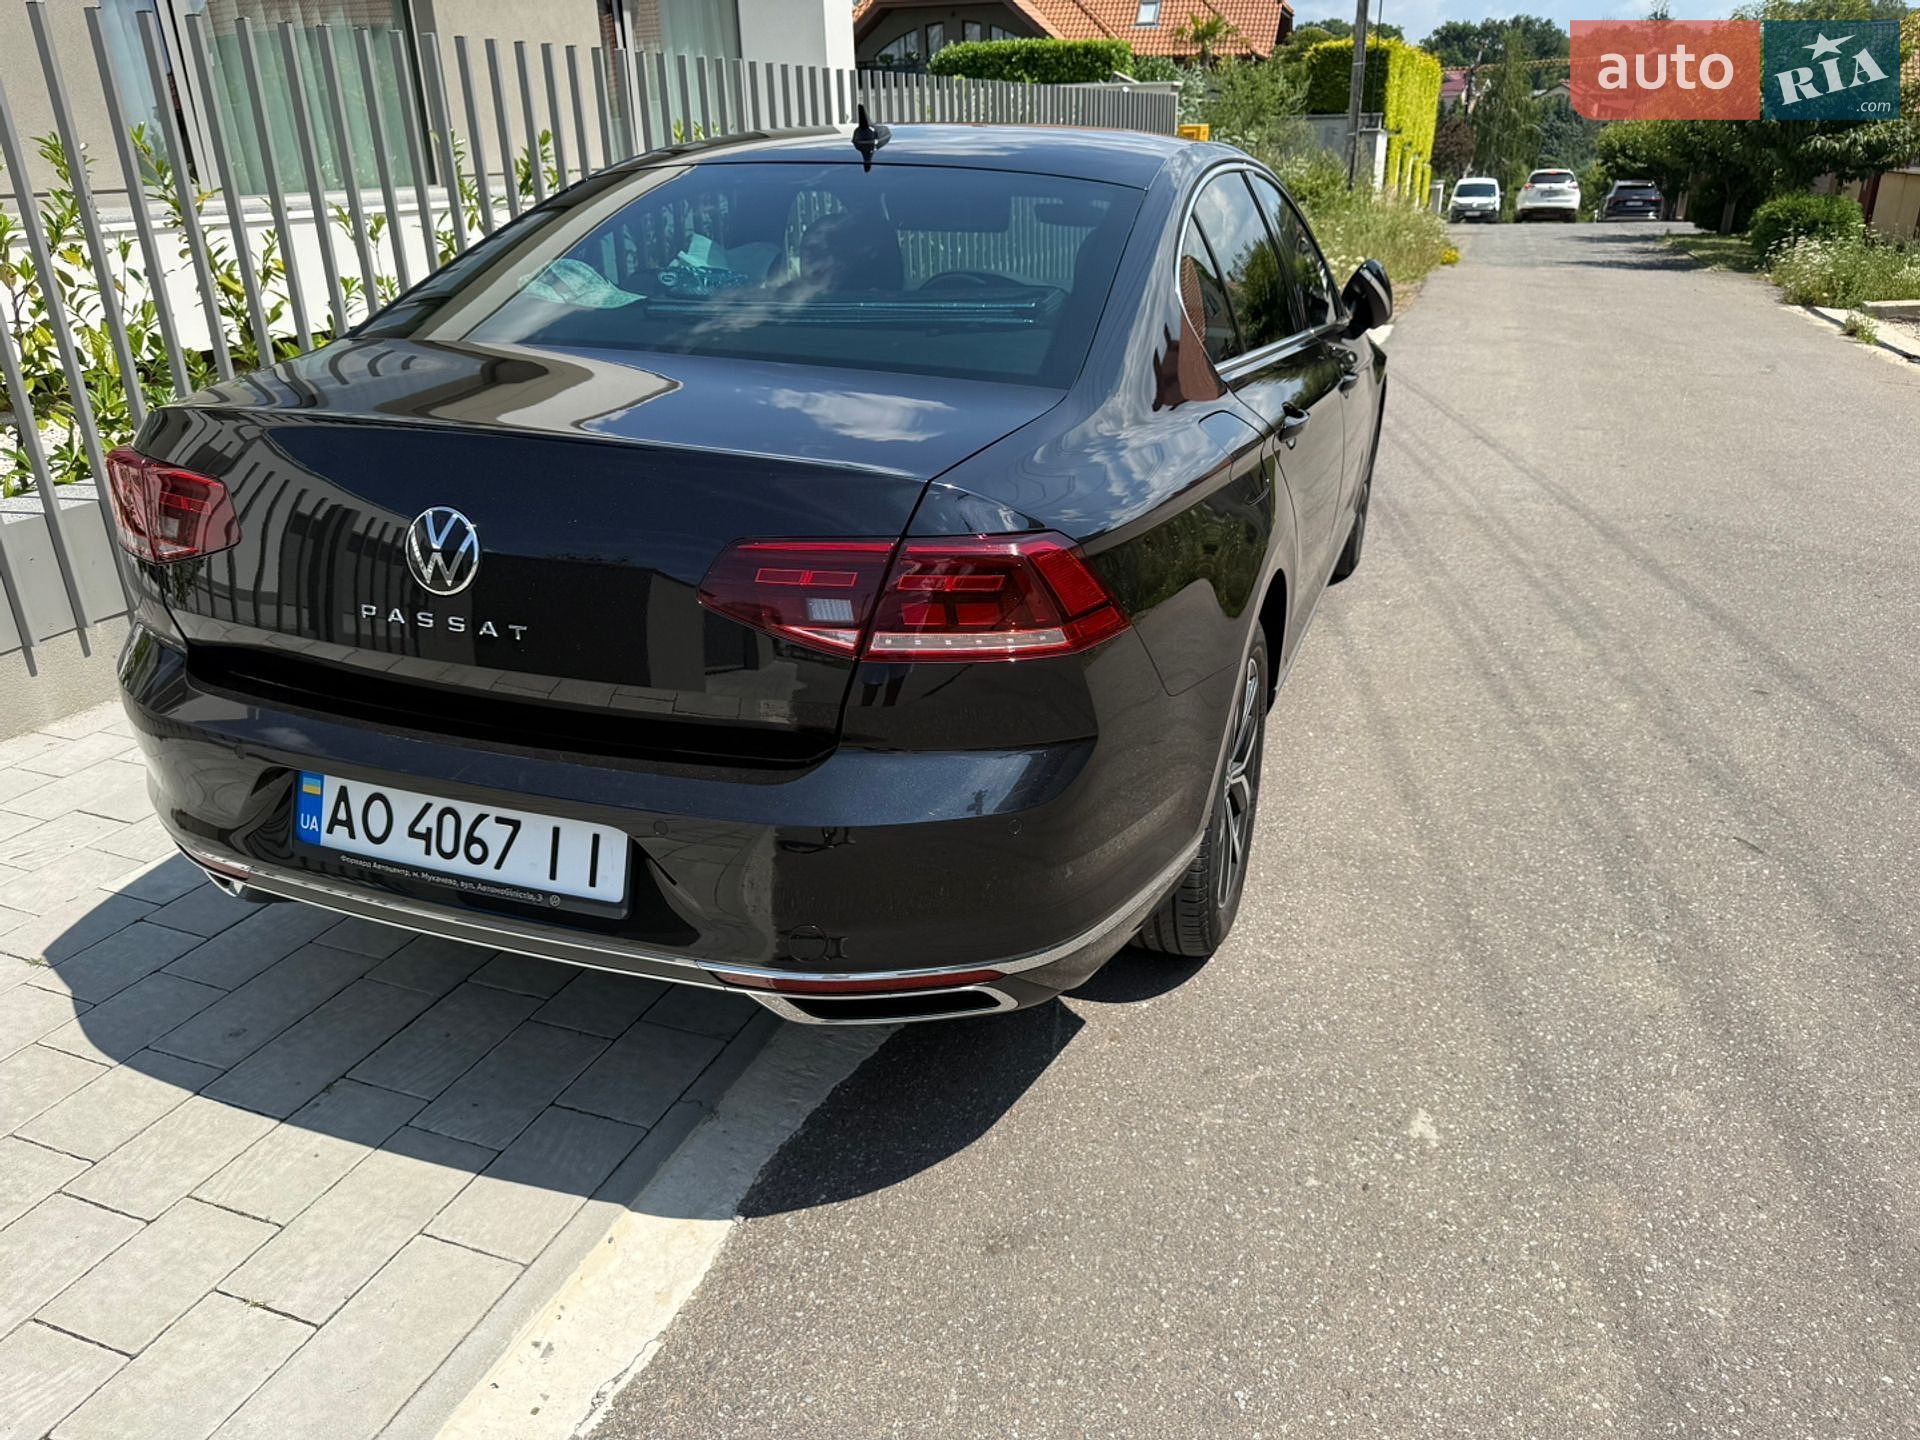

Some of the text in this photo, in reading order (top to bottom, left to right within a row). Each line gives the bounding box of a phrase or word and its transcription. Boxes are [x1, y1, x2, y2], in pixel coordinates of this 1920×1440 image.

[360, 604, 528, 641] PASSAT
[300, 813, 319, 832] UA
[326, 785, 394, 845] AO
[408, 802, 522, 871] 4067
